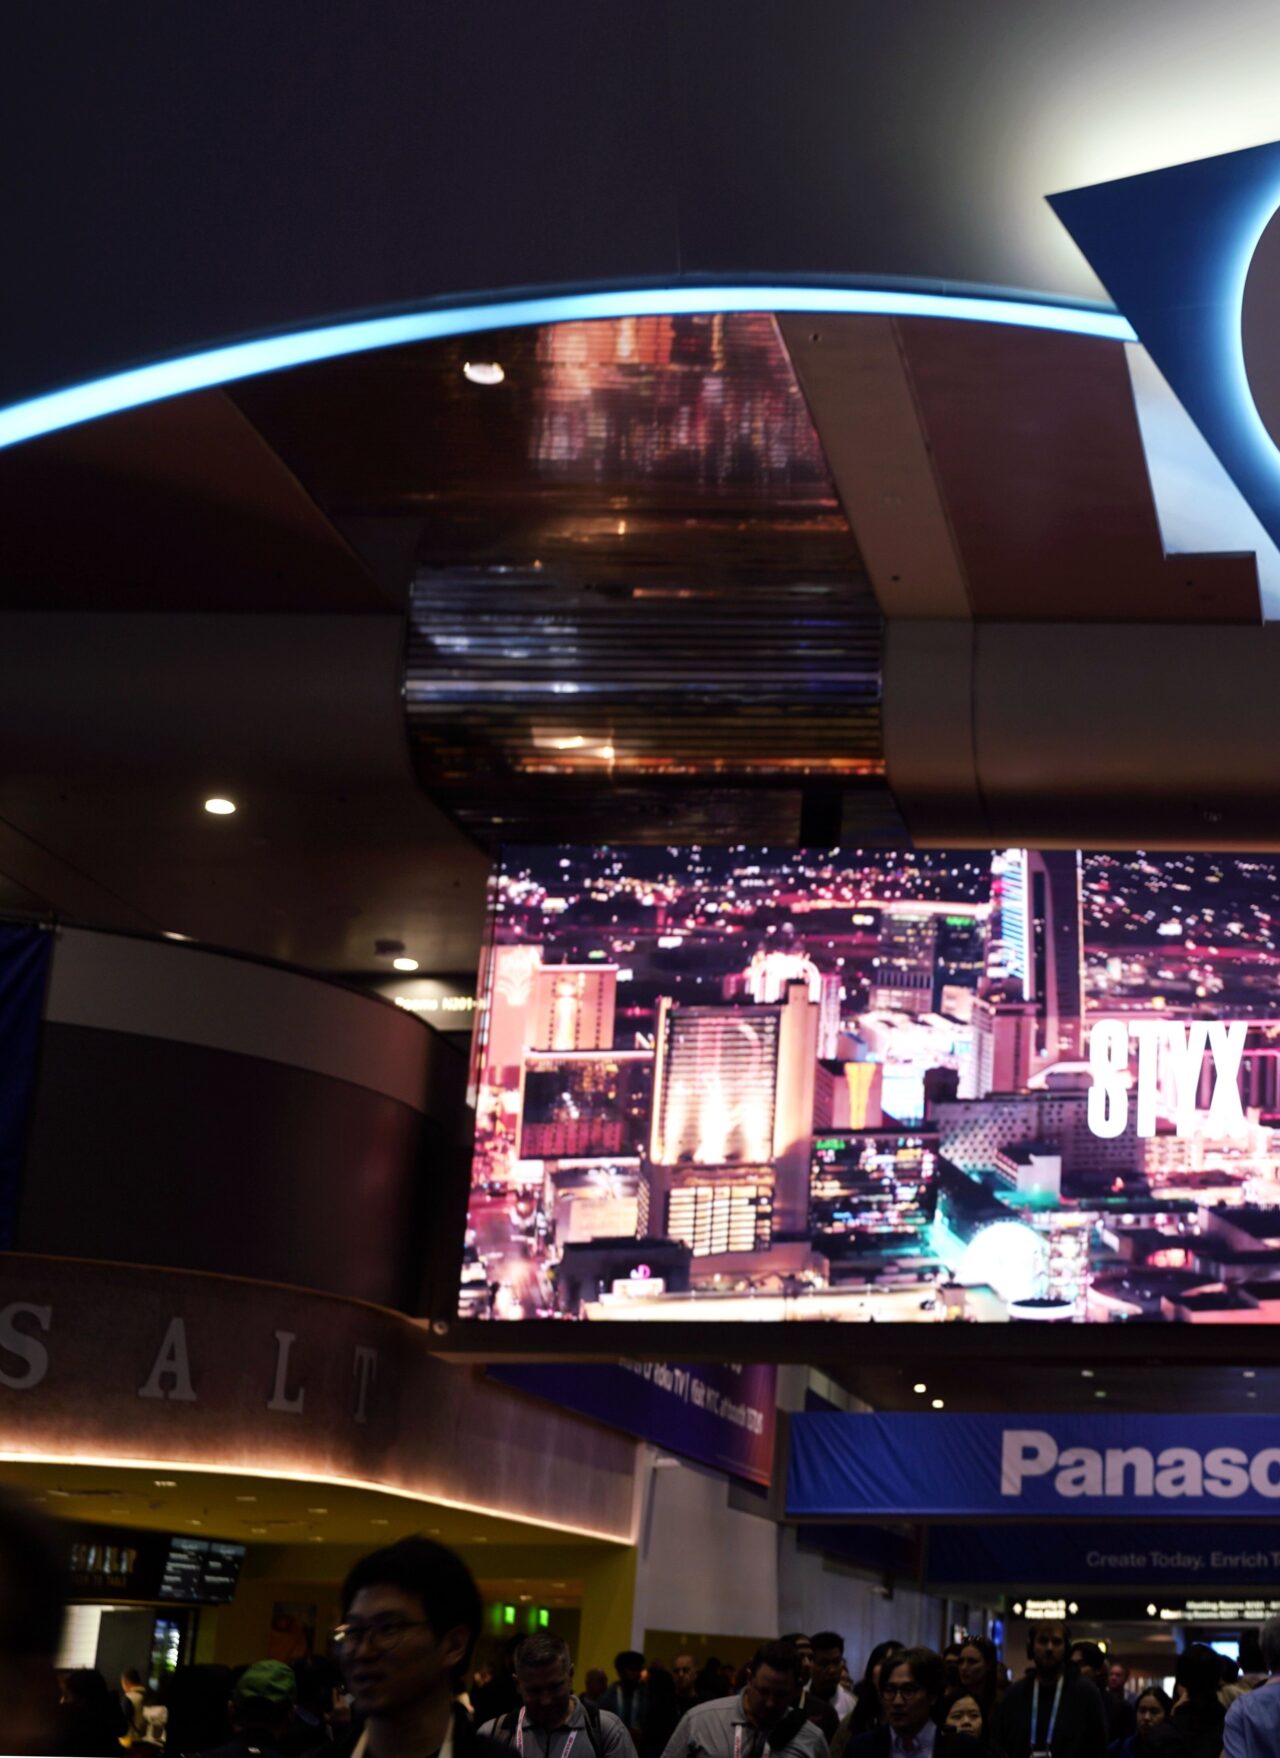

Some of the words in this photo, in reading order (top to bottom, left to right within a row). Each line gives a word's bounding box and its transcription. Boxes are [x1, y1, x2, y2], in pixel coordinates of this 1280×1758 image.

[1087, 1018, 1248, 1140] STYX
[1086, 1551, 1147, 1569] Create
[1150, 1551, 1205, 1571] Today.
[1210, 1551, 1268, 1569] Enrich
